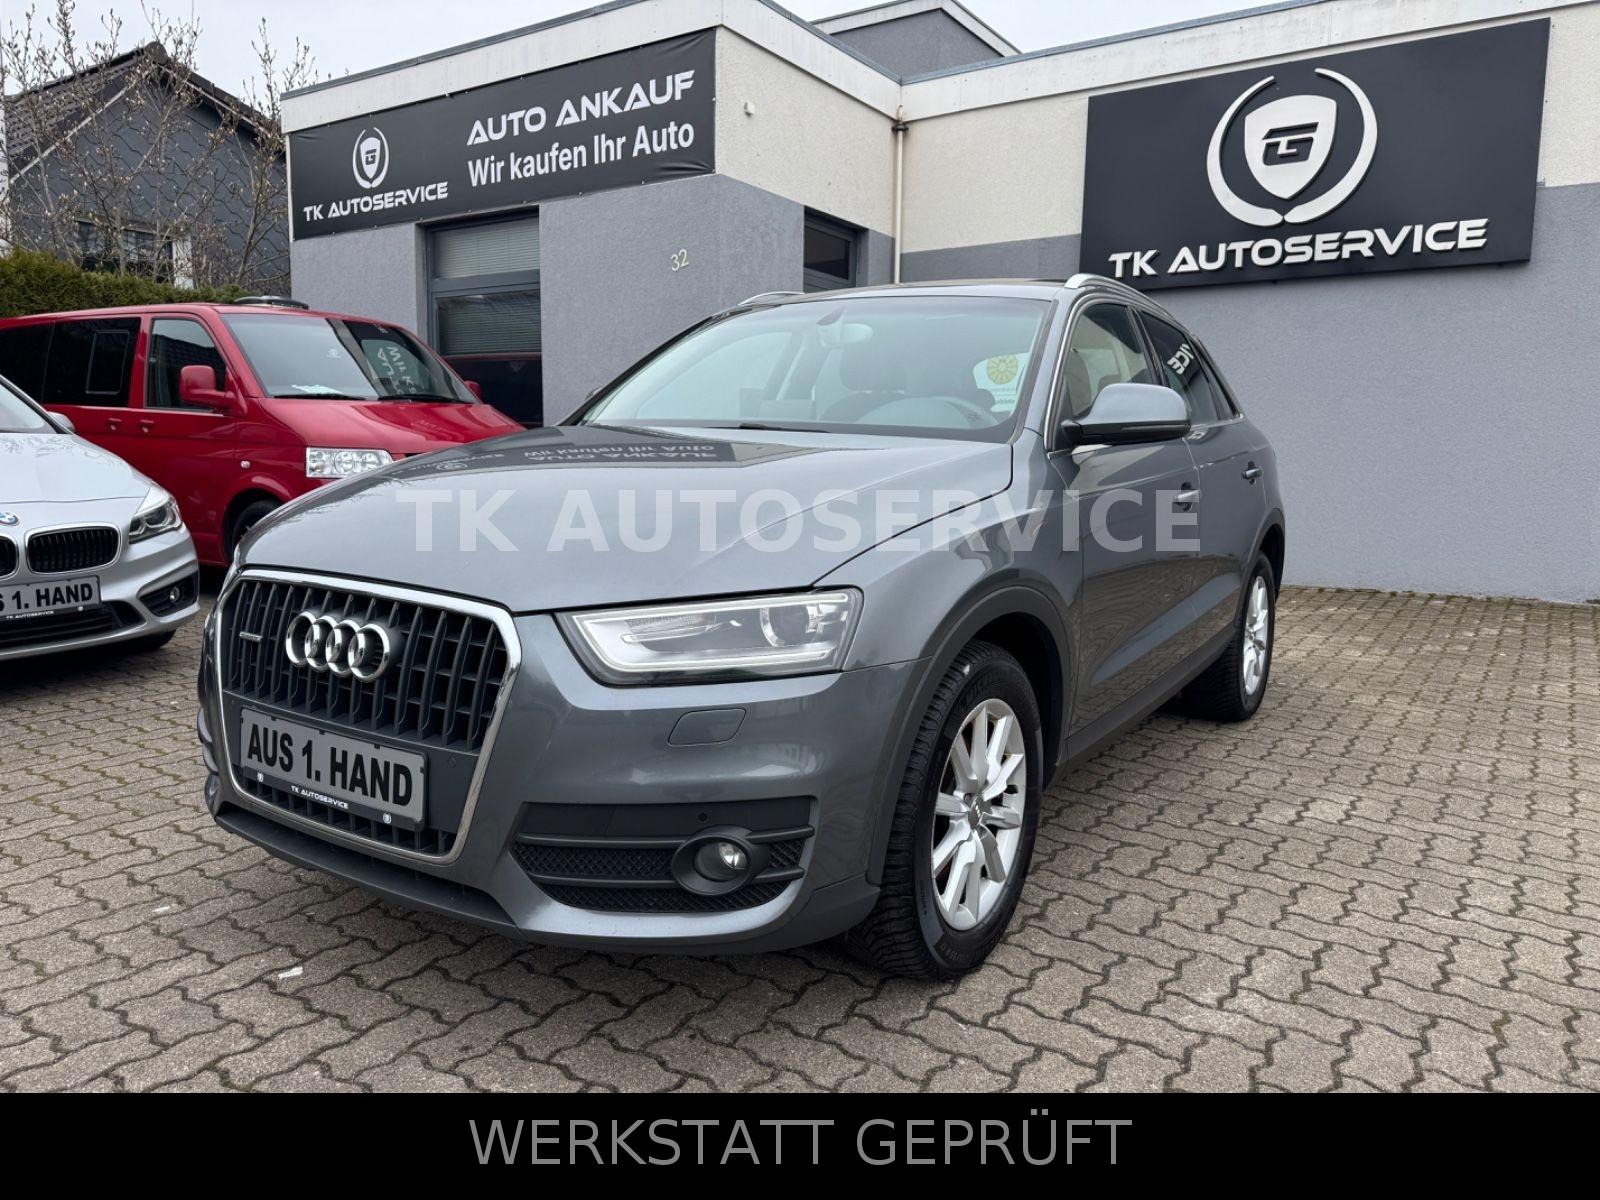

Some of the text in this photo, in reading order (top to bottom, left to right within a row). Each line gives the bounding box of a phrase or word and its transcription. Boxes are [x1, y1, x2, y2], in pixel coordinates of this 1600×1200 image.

[466, 70, 695, 146] AUTO ANKAUF
[468, 121, 695, 187] Wir kaufen Ihr Auto
[303, 181, 449, 222] TK AUTOSERVICE
[670, 249, 689, 271] 32
[1108, 217, 1490, 278] TK AUTOSERVICE
[12, 590, 29, 610] 1.
[36, 583, 93, 607] HAND
[247, 722, 413, 806] AUS 1. HAND
[291, 785, 349, 809] TK AUTOSERVICE
